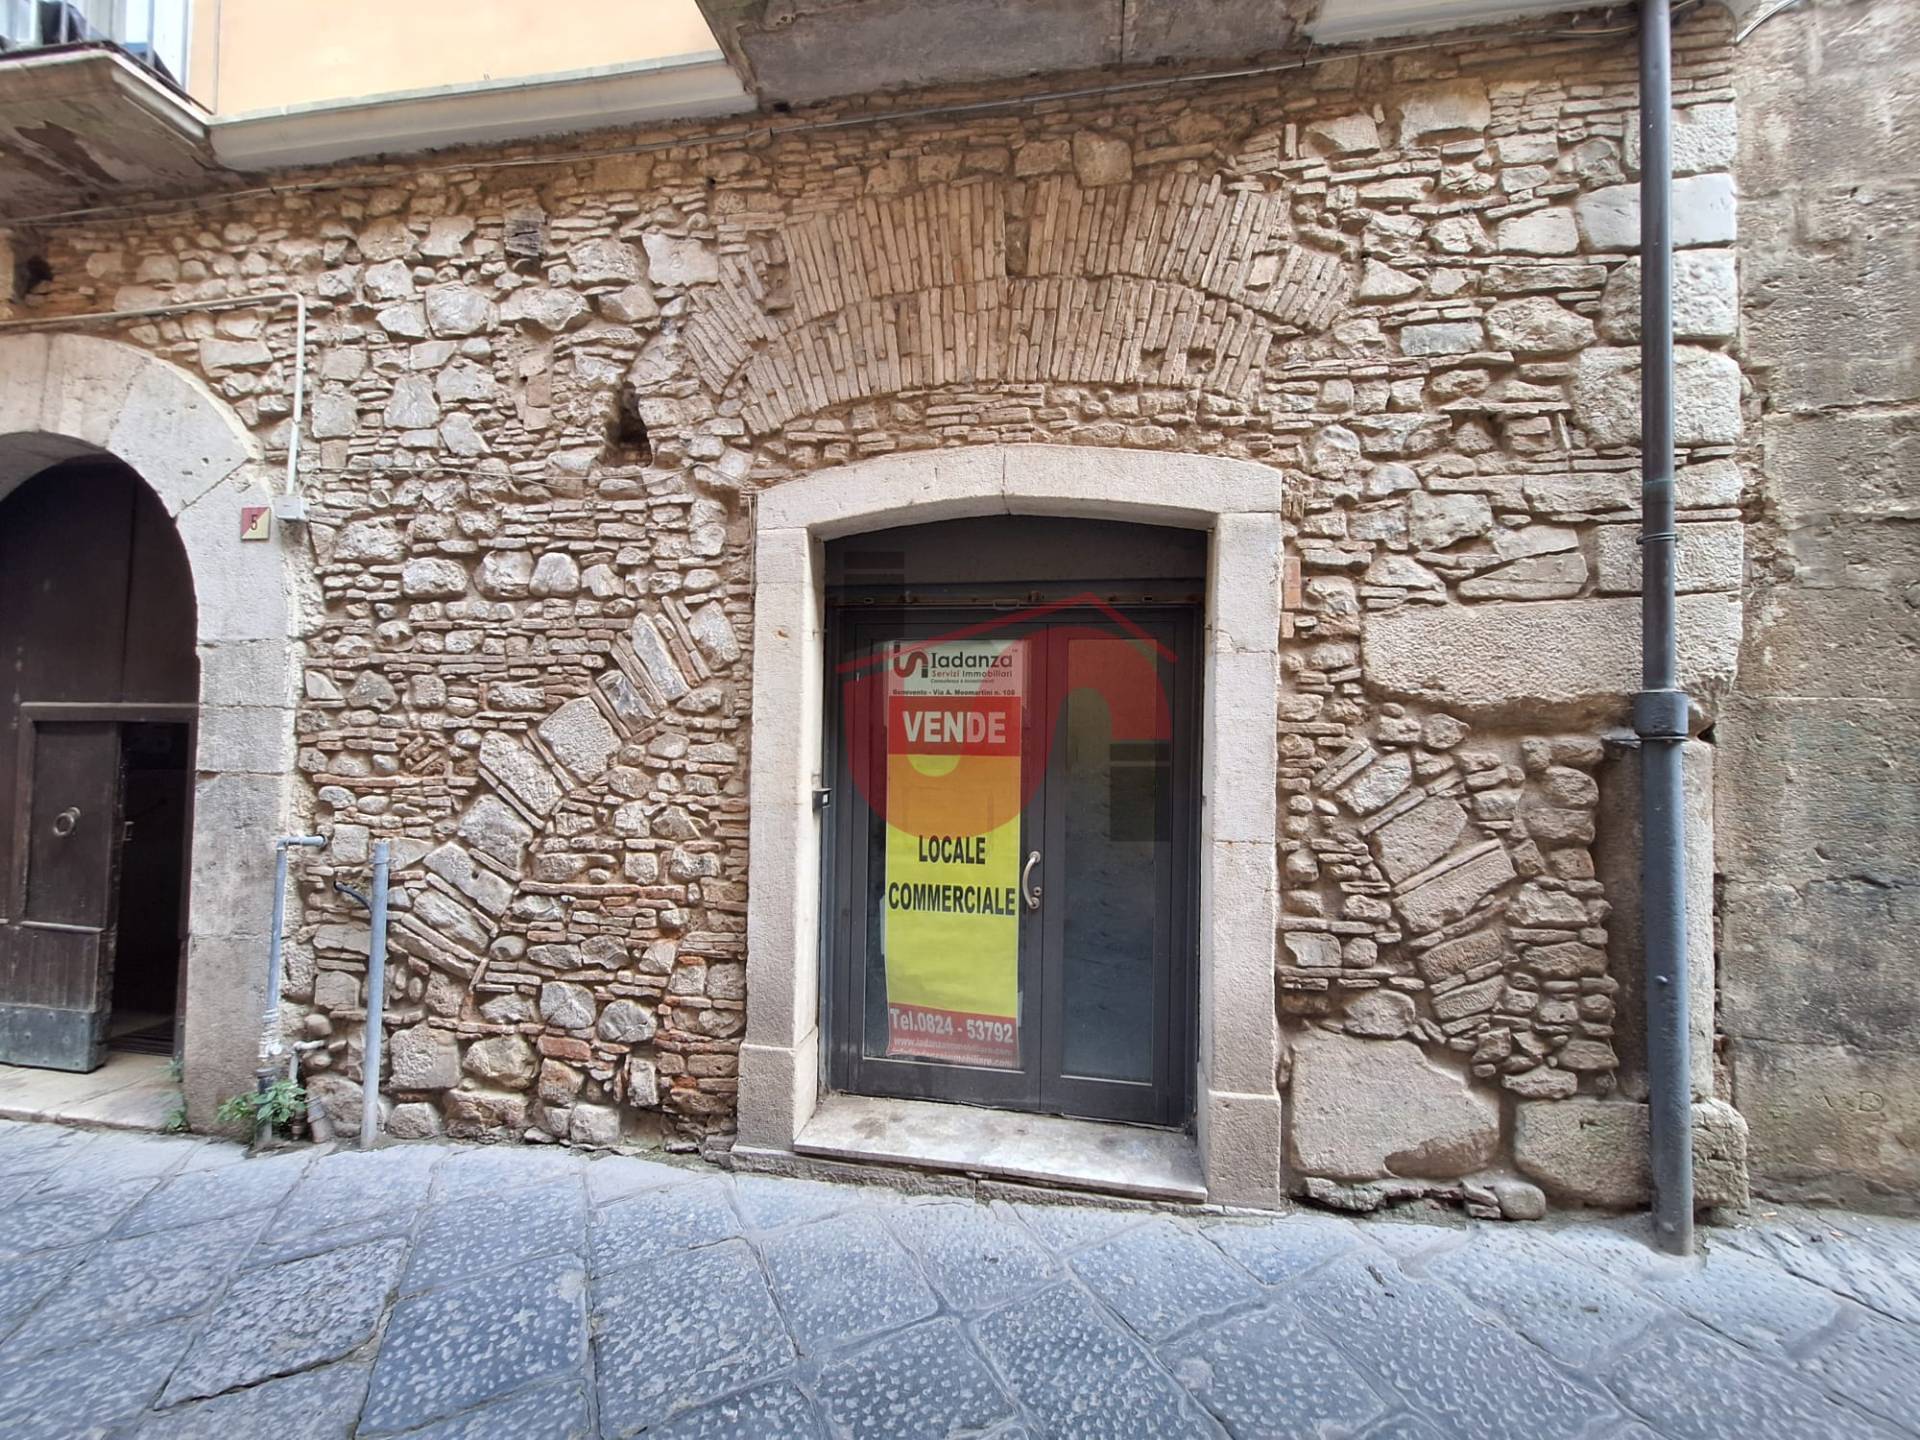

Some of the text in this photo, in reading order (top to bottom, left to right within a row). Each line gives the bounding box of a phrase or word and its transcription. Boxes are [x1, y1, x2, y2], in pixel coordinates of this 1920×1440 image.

[250, 513, 258, 531] 5
[931, 651, 1013, 669] Iadanza
[931, 670, 1013, 678] Servizi Immobiliari
[902, 711, 1007, 743] VENDE
[918, 835, 986, 865] LOCALE
[888, 882, 1016, 916] COMMERCIALE
[890, 1008, 954, 1036] Tel.0824
[965, 1019, 1014, 1044] 53792
